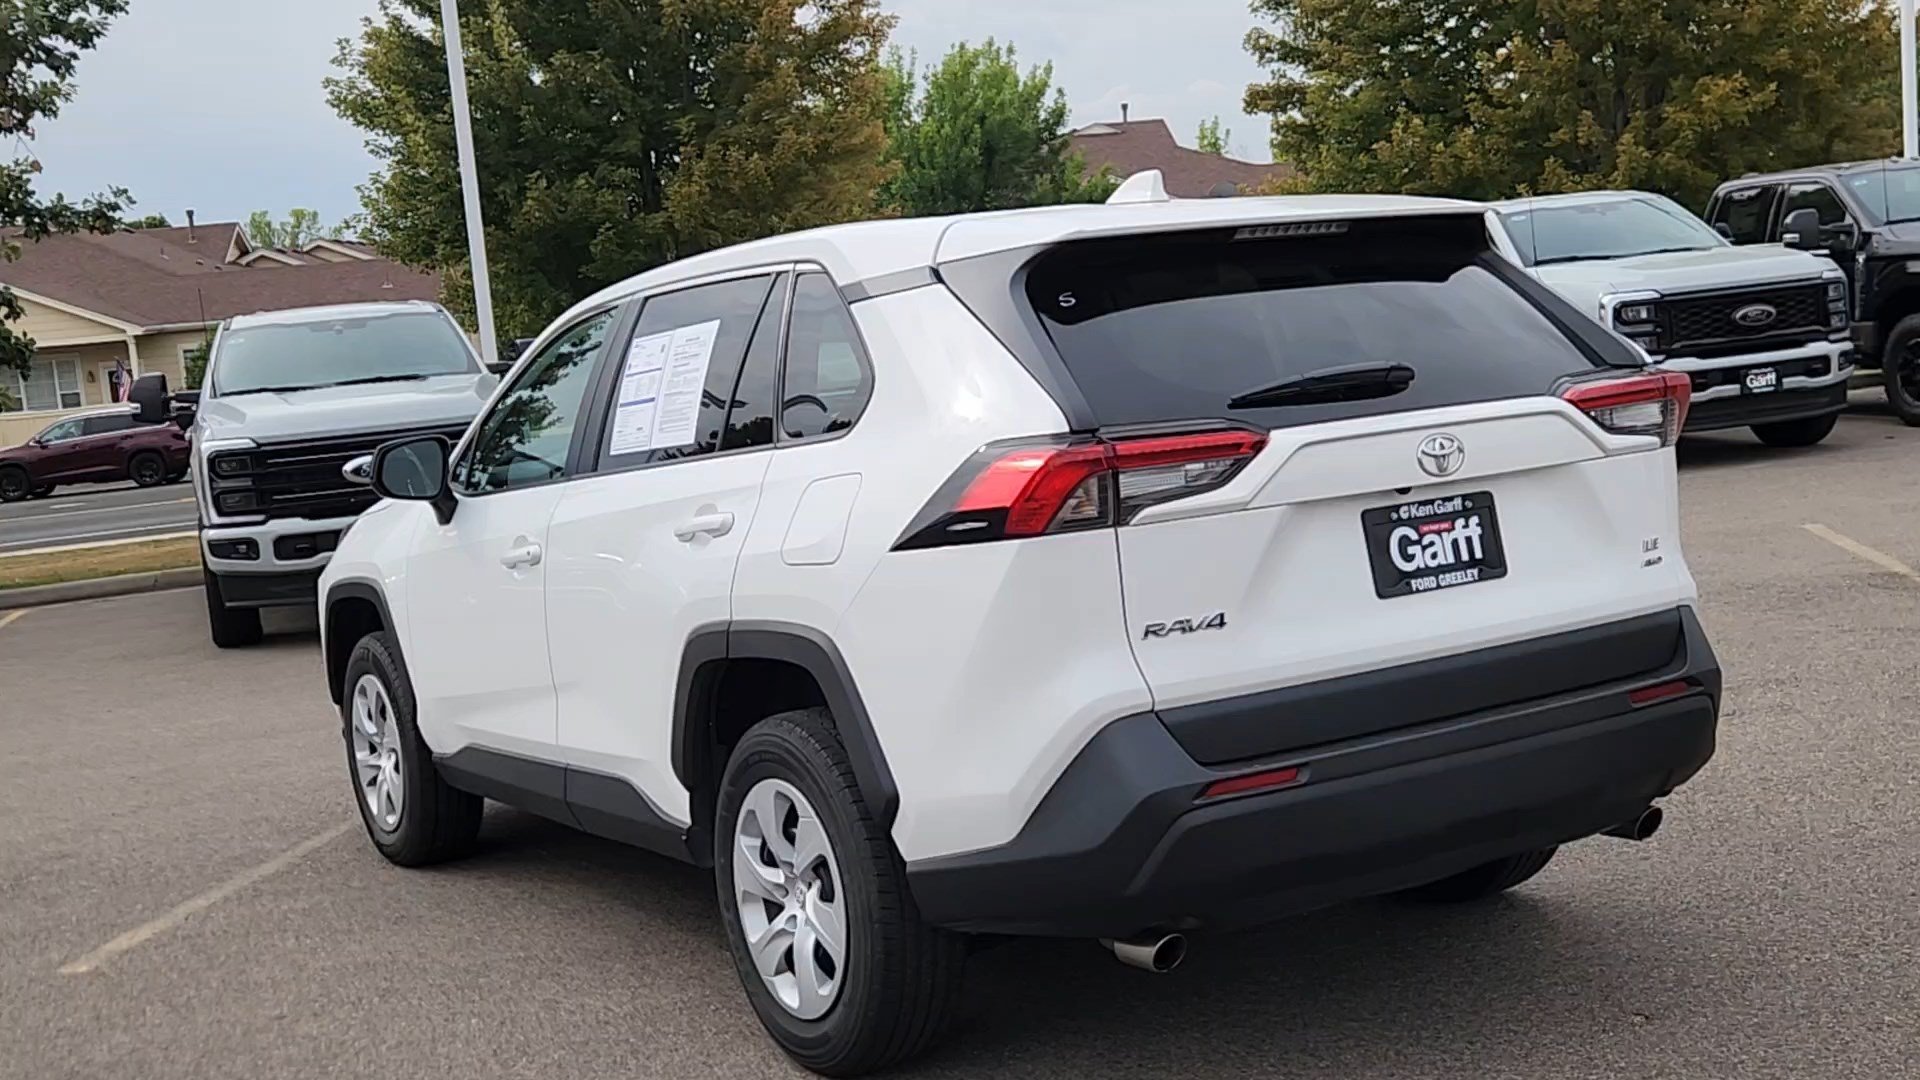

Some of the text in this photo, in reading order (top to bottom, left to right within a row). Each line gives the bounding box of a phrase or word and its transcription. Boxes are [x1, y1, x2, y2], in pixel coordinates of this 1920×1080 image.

[1410, 496, 1463, 518] Ken Garff
[1389, 515, 1484, 572] Garff
[1411, 567, 1479, 591] FORD GREELEY
[1141, 611, 1227, 640] RAV4
